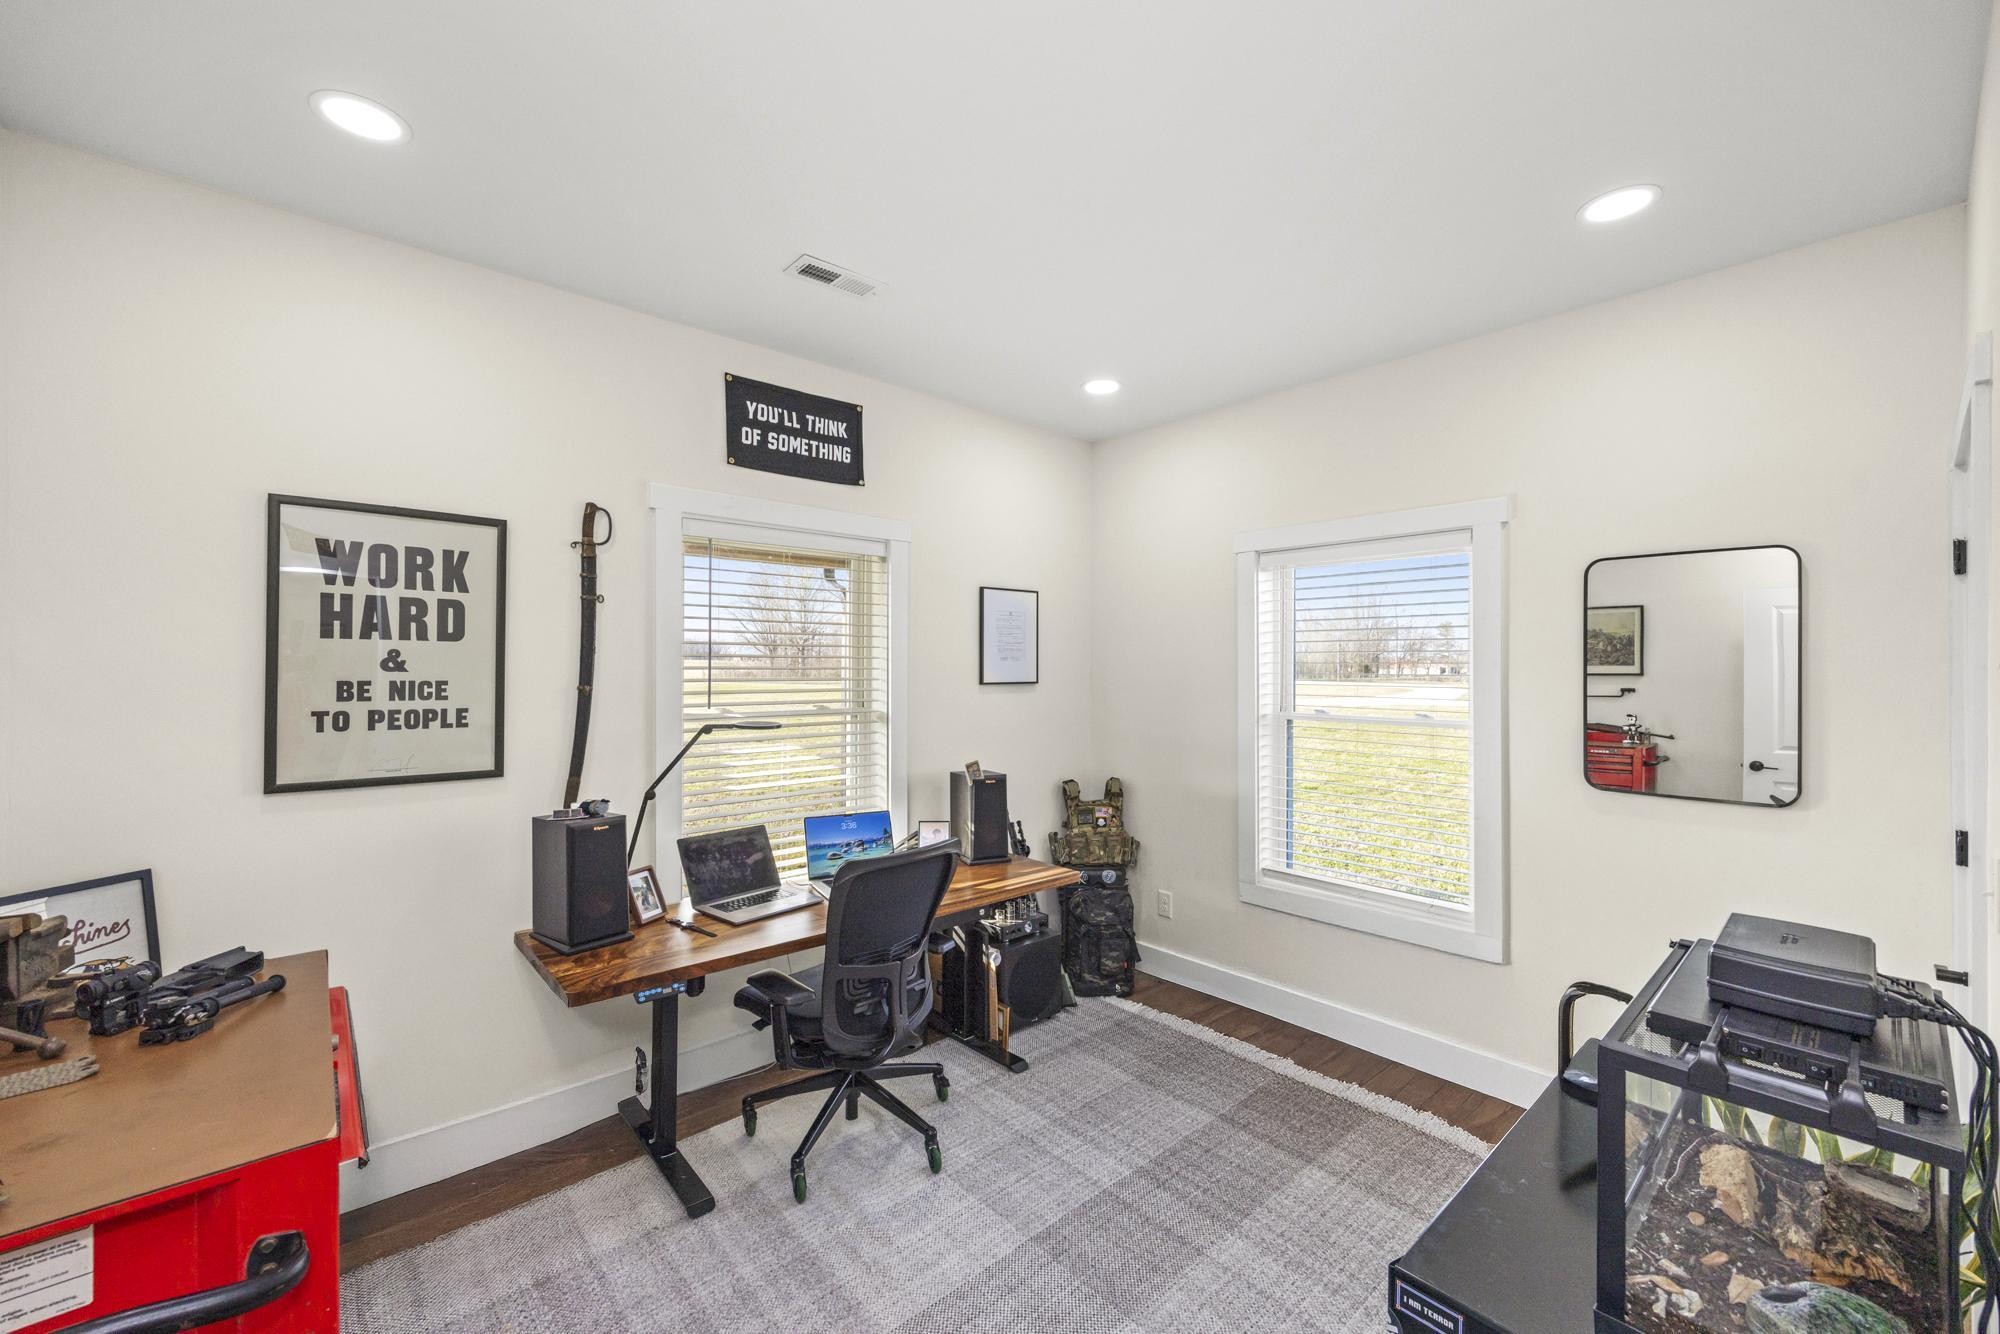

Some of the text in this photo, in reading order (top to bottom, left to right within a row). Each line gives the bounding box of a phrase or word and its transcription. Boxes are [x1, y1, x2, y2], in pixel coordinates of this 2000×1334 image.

[746, 400, 848, 439] YOU'LL THINK
[741, 426, 851, 463] OF SOMETHING
[315, 537, 470, 594] WORK
[319, 592, 466, 643] HARD
[379, 648, 410, 673] &
[336, 680, 449, 702] BE NICE
[310, 707, 469, 733] TO PEOPLE
[72, 919, 130, 948] hines
[1403, 1295, 1454, 1330] I AM TERROR
